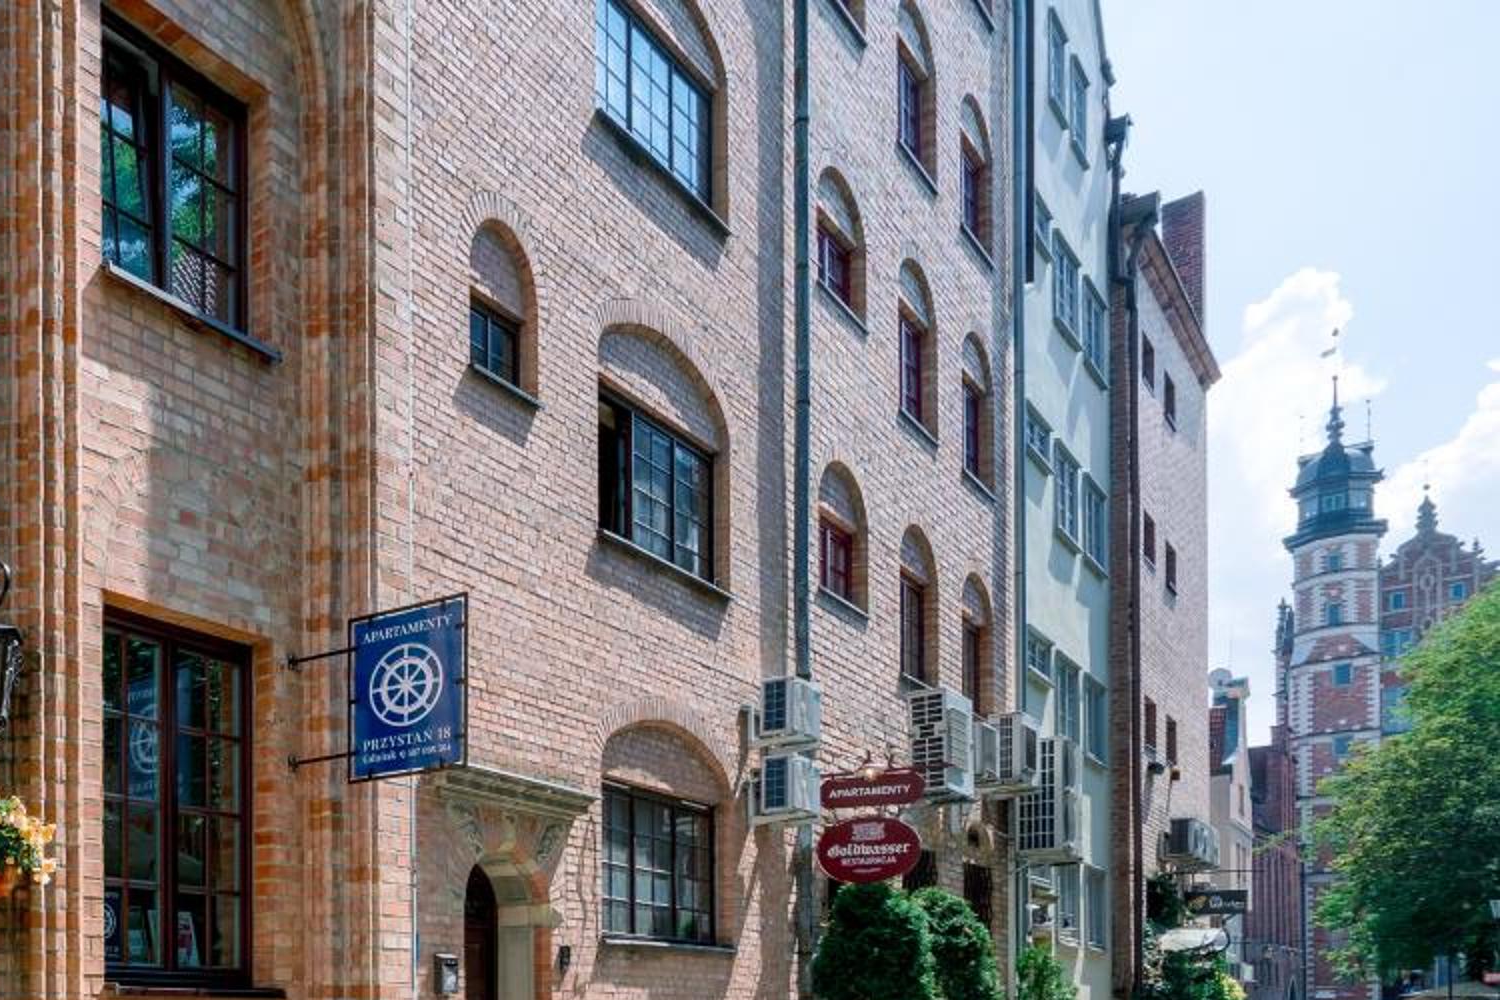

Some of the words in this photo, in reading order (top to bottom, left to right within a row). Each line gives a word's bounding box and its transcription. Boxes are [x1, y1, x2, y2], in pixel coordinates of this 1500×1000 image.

[363, 613, 453, 644] APARTAMENTY
[438, 726, 451, 740] 18
[829, 783, 911, 799] APARTAMENTY
[827, 842, 911, 859] Goldwasser
